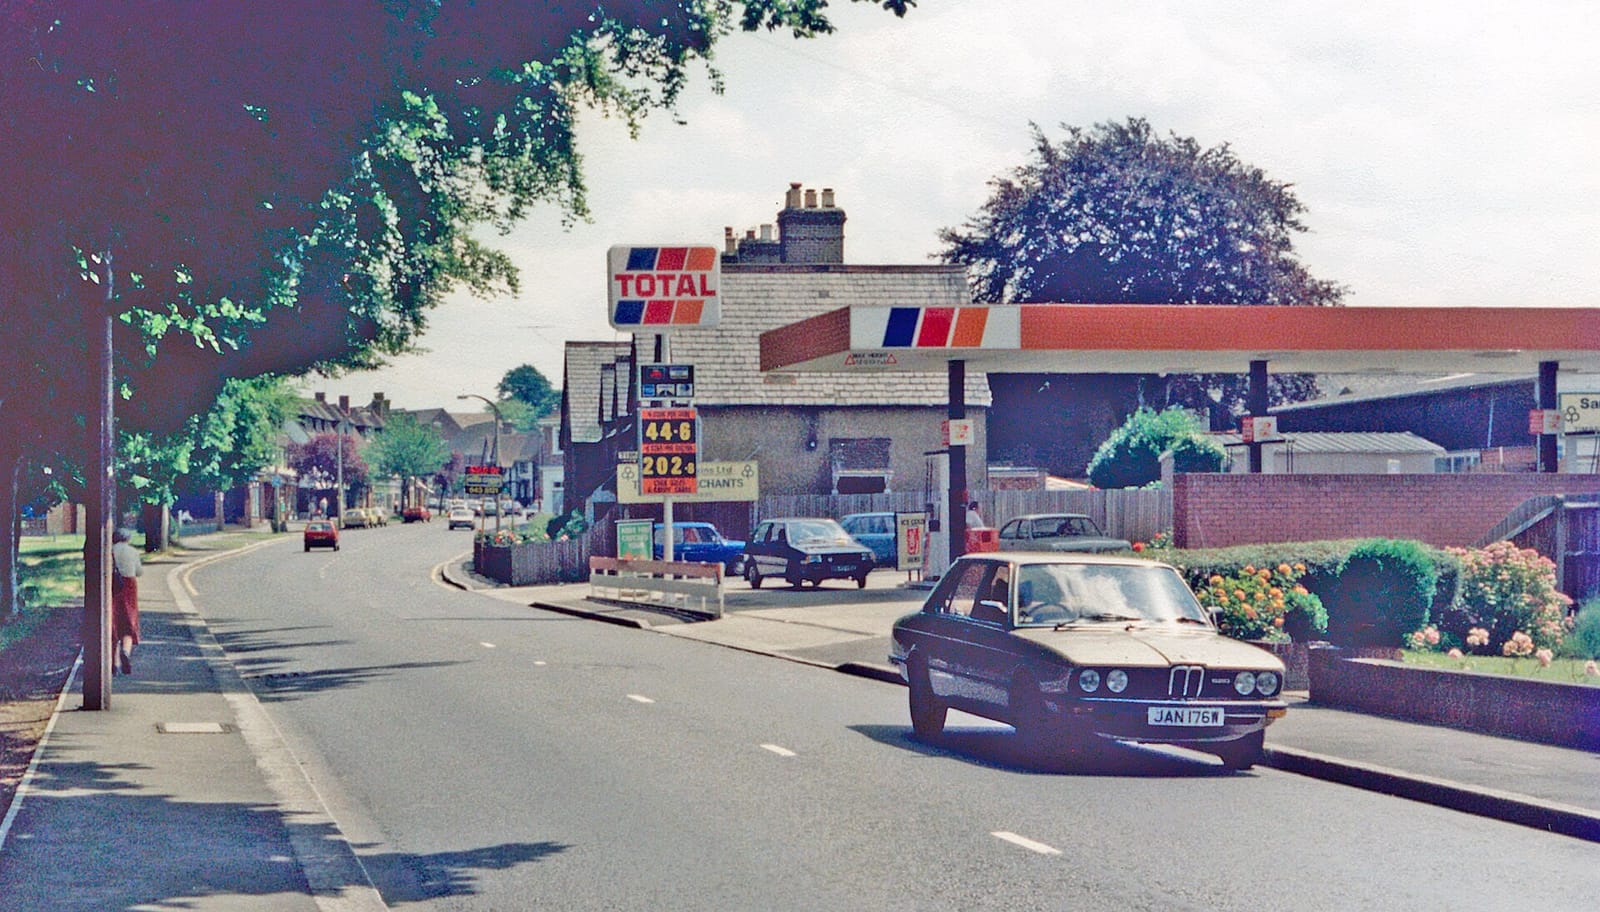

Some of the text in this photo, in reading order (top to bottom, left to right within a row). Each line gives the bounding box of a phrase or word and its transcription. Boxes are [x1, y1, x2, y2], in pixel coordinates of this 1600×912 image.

[614, 273, 716, 297] TOTAL
[716, 466, 732, 474] Ltd
[697, 478, 744, 488] CHANTS
[1153, 711, 1219, 724] JAN 176W
